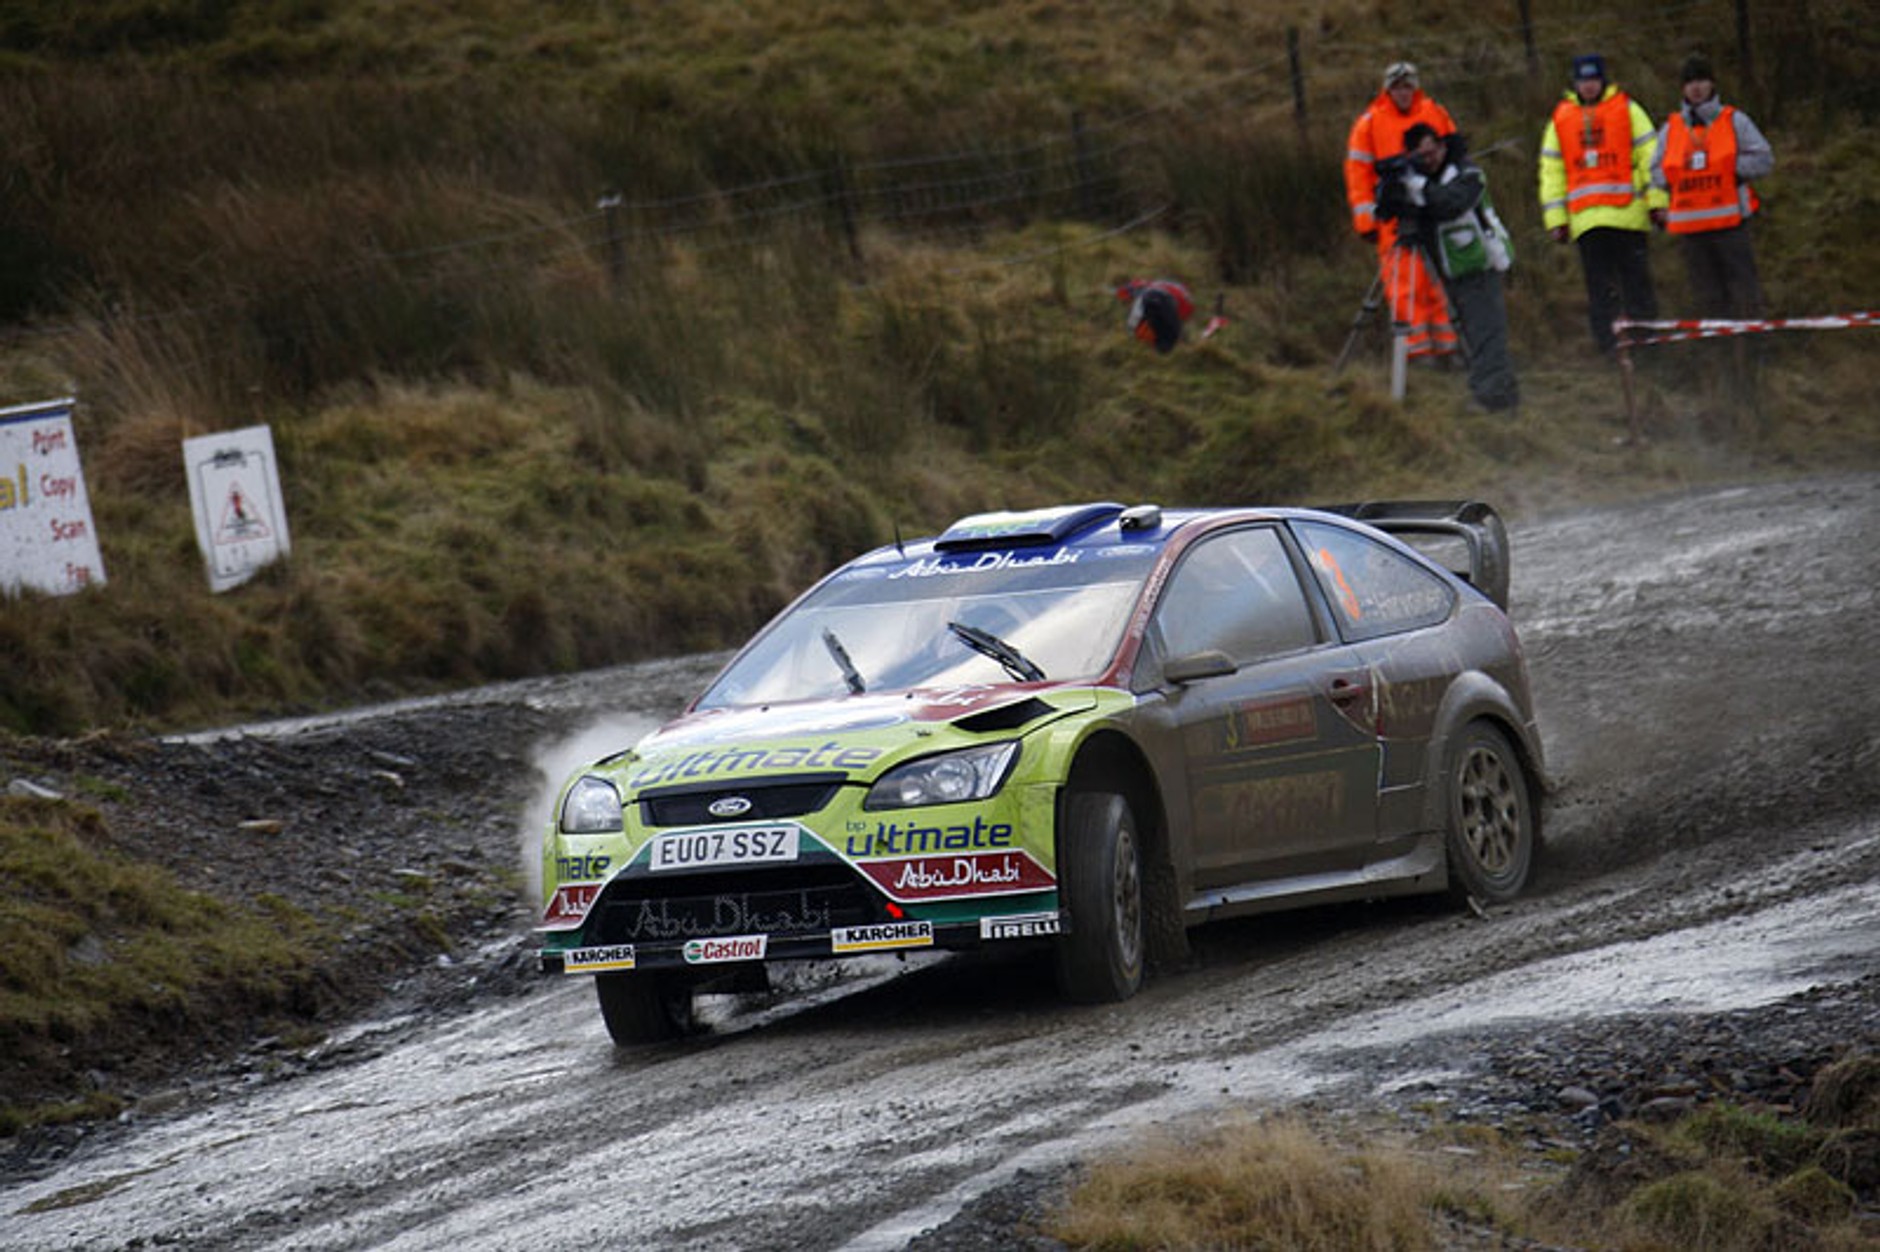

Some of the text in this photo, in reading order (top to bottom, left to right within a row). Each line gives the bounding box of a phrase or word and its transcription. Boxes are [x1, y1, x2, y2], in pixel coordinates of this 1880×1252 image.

[33, 429, 67, 453] Print
[40, 474, 77, 499] Copy
[50, 517, 87, 541] Scan
[629, 741, 885, 789] ultimate
[846, 821, 866, 833] bp
[846, 815, 1013, 857] ultimate
[660, 830, 787, 866] EU07 SSZ
[981, 911, 1060, 939] PIRELLI
[703, 937, 763, 959] Castrol
